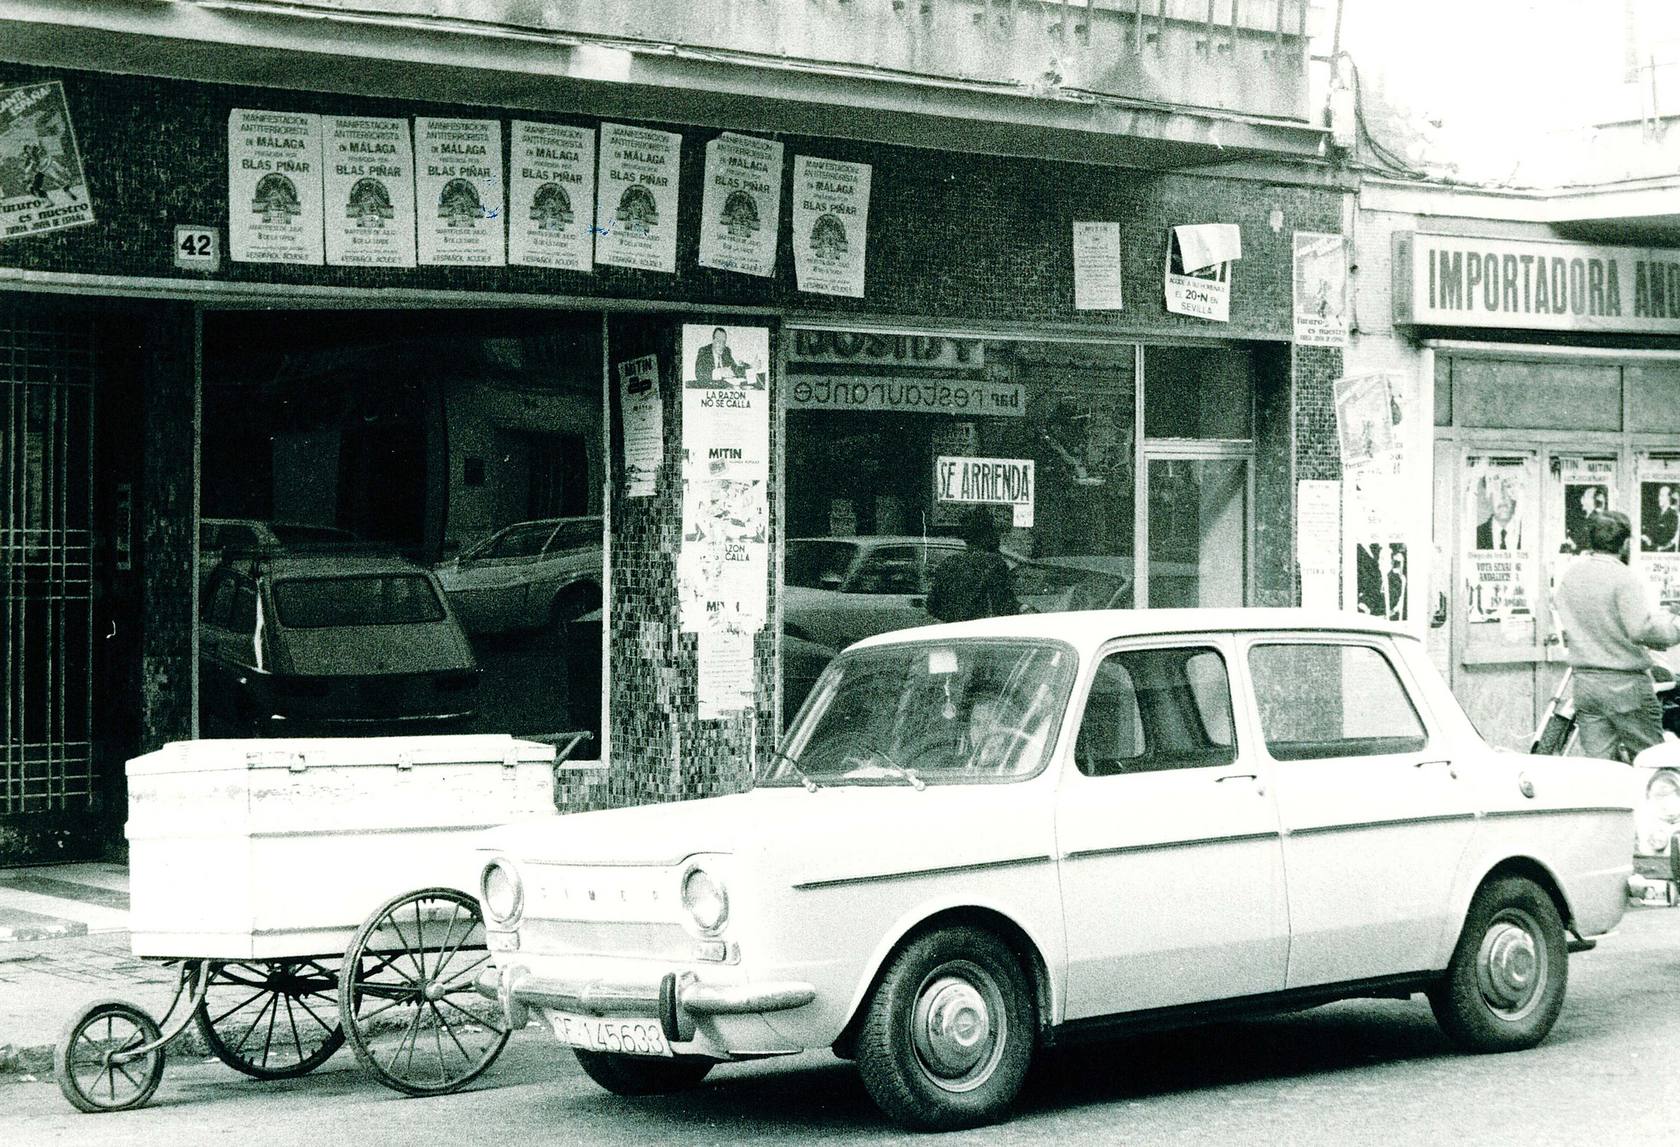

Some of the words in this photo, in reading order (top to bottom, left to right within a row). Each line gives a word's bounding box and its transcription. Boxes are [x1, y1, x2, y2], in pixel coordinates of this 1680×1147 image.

[242, 159, 272, 170] BLAS
[276, 160, 310, 173] PIÑAR
[336, 165, 365, 175] BLAS
[369, 164, 401, 177] PIÑAR
[427, 165, 456, 176] BLAS
[460, 164, 491, 177] PIÑAR
[522, 168, 549, 180] BLAS
[552, 170, 583, 184] PIÑAR
[0, 199, 41, 213] uturo
[19, 213, 32, 223] es
[38, 203, 89, 219] nuestro
[181, 234, 211, 256] 42
[1429, 249, 1622, 317] IMPORTADORA
[1181, 302, 1212, 314] SEVILLA
[706, 391, 716, 399] LA
[718, 391, 747, 400] RAZON
[701, 399, 714, 407] NO
[715, 399, 724, 408] SE
[726, 399, 751, 408] CALLA
[709, 448, 742, 459] MITIN
[1587, 463, 1612, 473] MITIN
[940, 462, 957, 499] SE
[961, 463, 1029, 500] ARRIENDA
[725, 552, 750, 562] CALLA
